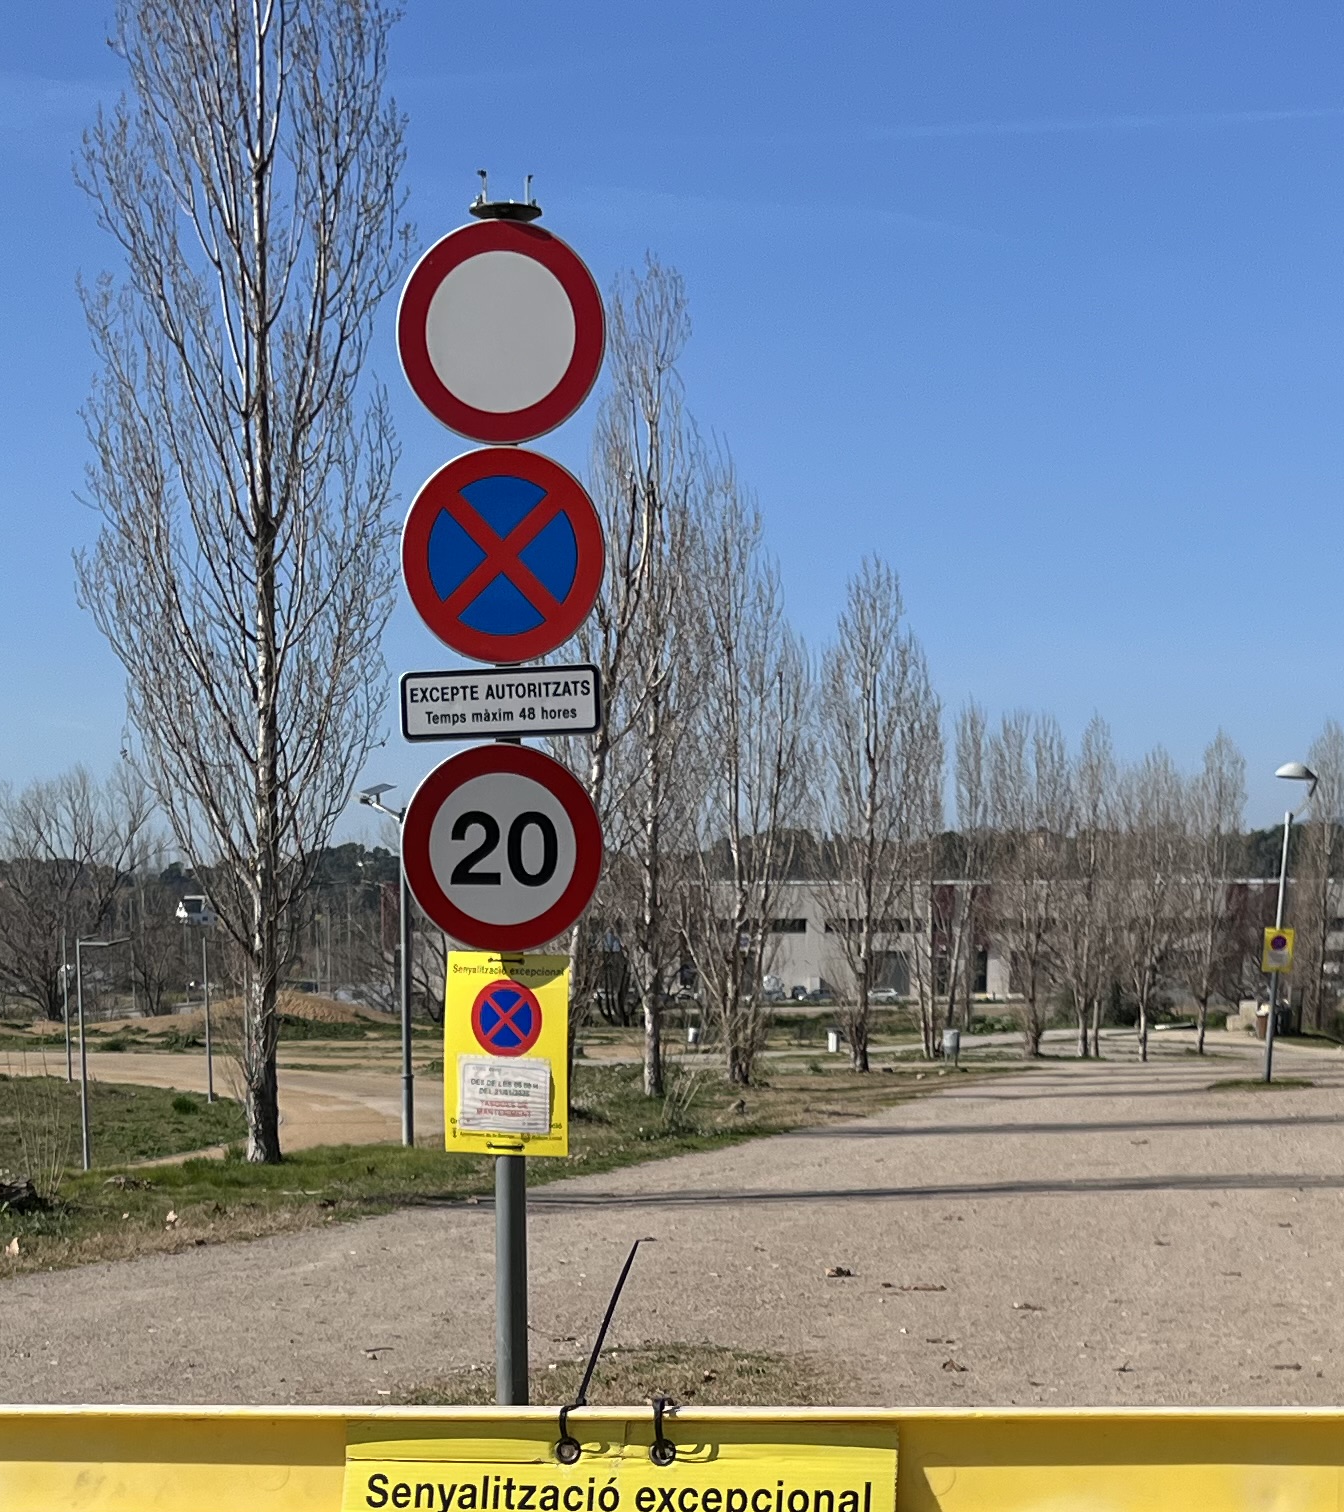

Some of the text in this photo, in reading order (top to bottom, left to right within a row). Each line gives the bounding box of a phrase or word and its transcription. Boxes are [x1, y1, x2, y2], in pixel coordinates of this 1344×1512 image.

[410, 680, 591, 703] EXCEPTE AUTORITZATS
[425, 706, 577, 726] Temps màxim 48 hores
[450, 810, 558, 887] 20
[510, 967, 564, 977] excepcional
